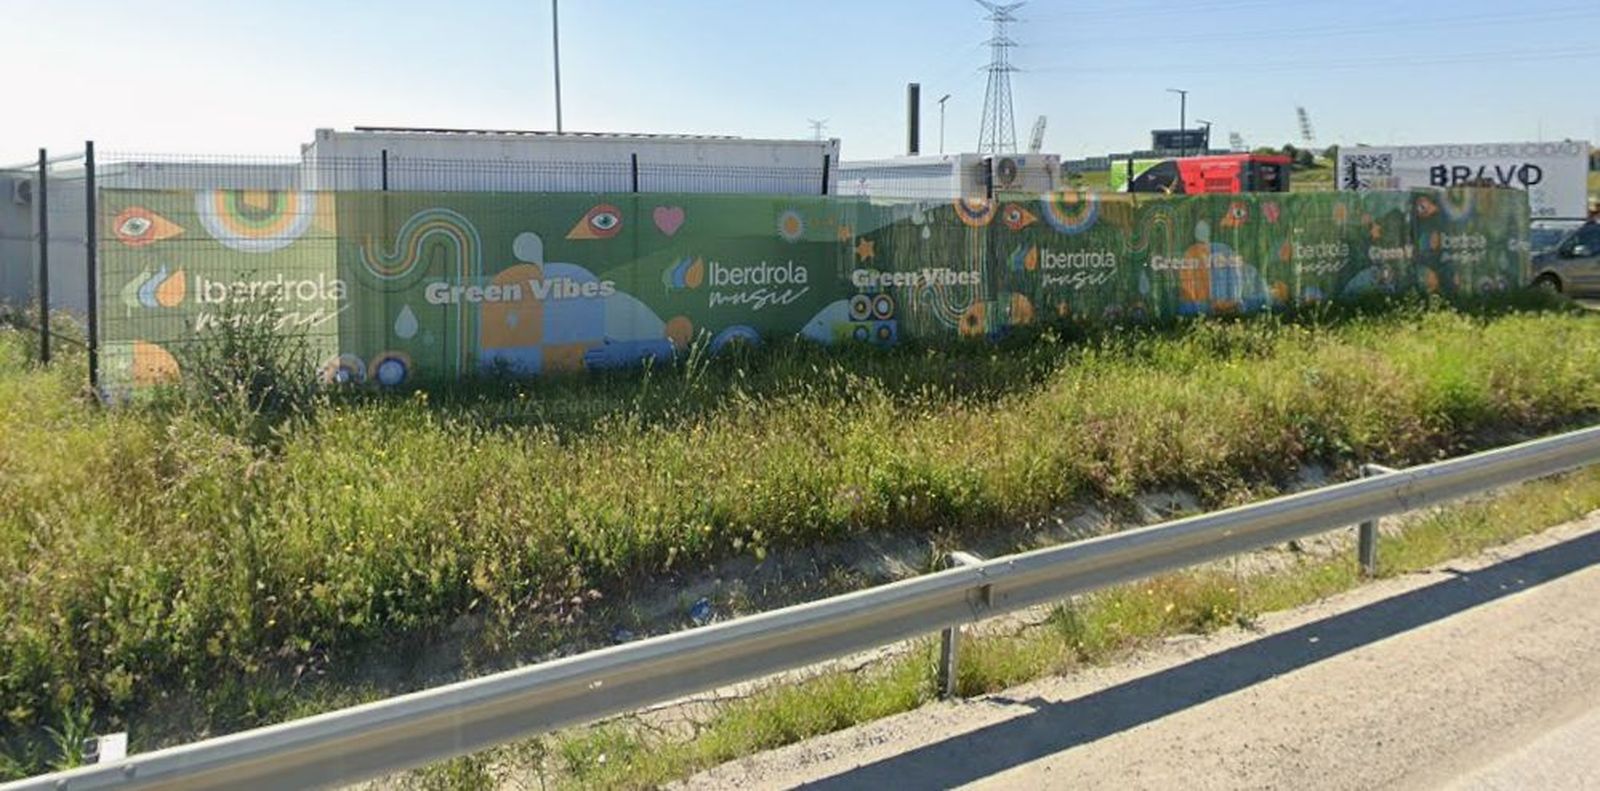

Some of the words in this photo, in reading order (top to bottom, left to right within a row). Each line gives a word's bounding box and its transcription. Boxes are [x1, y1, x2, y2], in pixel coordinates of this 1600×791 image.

[1041, 247, 1116, 269] Iberdrola
[708, 259, 808, 286] Iberdrola
[851, 268, 921, 288] Green
[921, 266, 981, 286] Vibes
[194, 272, 347, 304] Iberdrola
[424, 280, 522, 305] Green
[528, 276, 616, 301] Vibes
[708, 285, 810, 311] music
